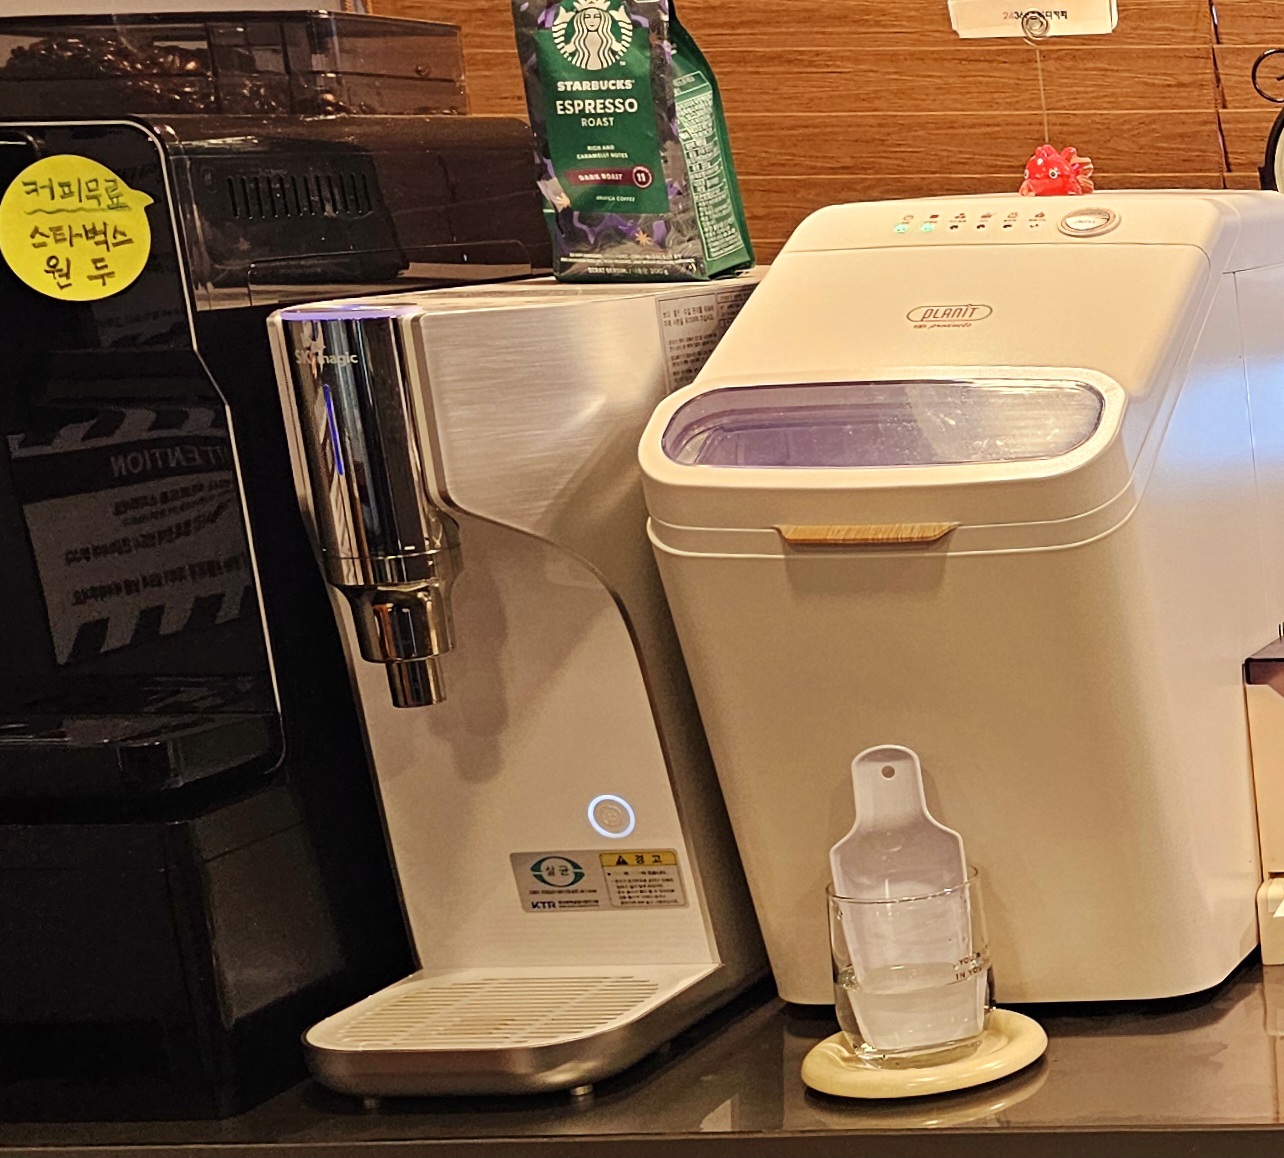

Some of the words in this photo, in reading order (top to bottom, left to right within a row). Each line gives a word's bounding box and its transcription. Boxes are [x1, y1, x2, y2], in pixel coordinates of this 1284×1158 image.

[557, 79, 635, 92] STARBUCKS
[556, 98, 638, 115] ESPRESSO
[581, 117, 615, 127] ROAST
[21, 177, 131, 210] 커피무료
[29, 221, 135, 253] 스타벅스
[531, 900, 557, 909] KTR
